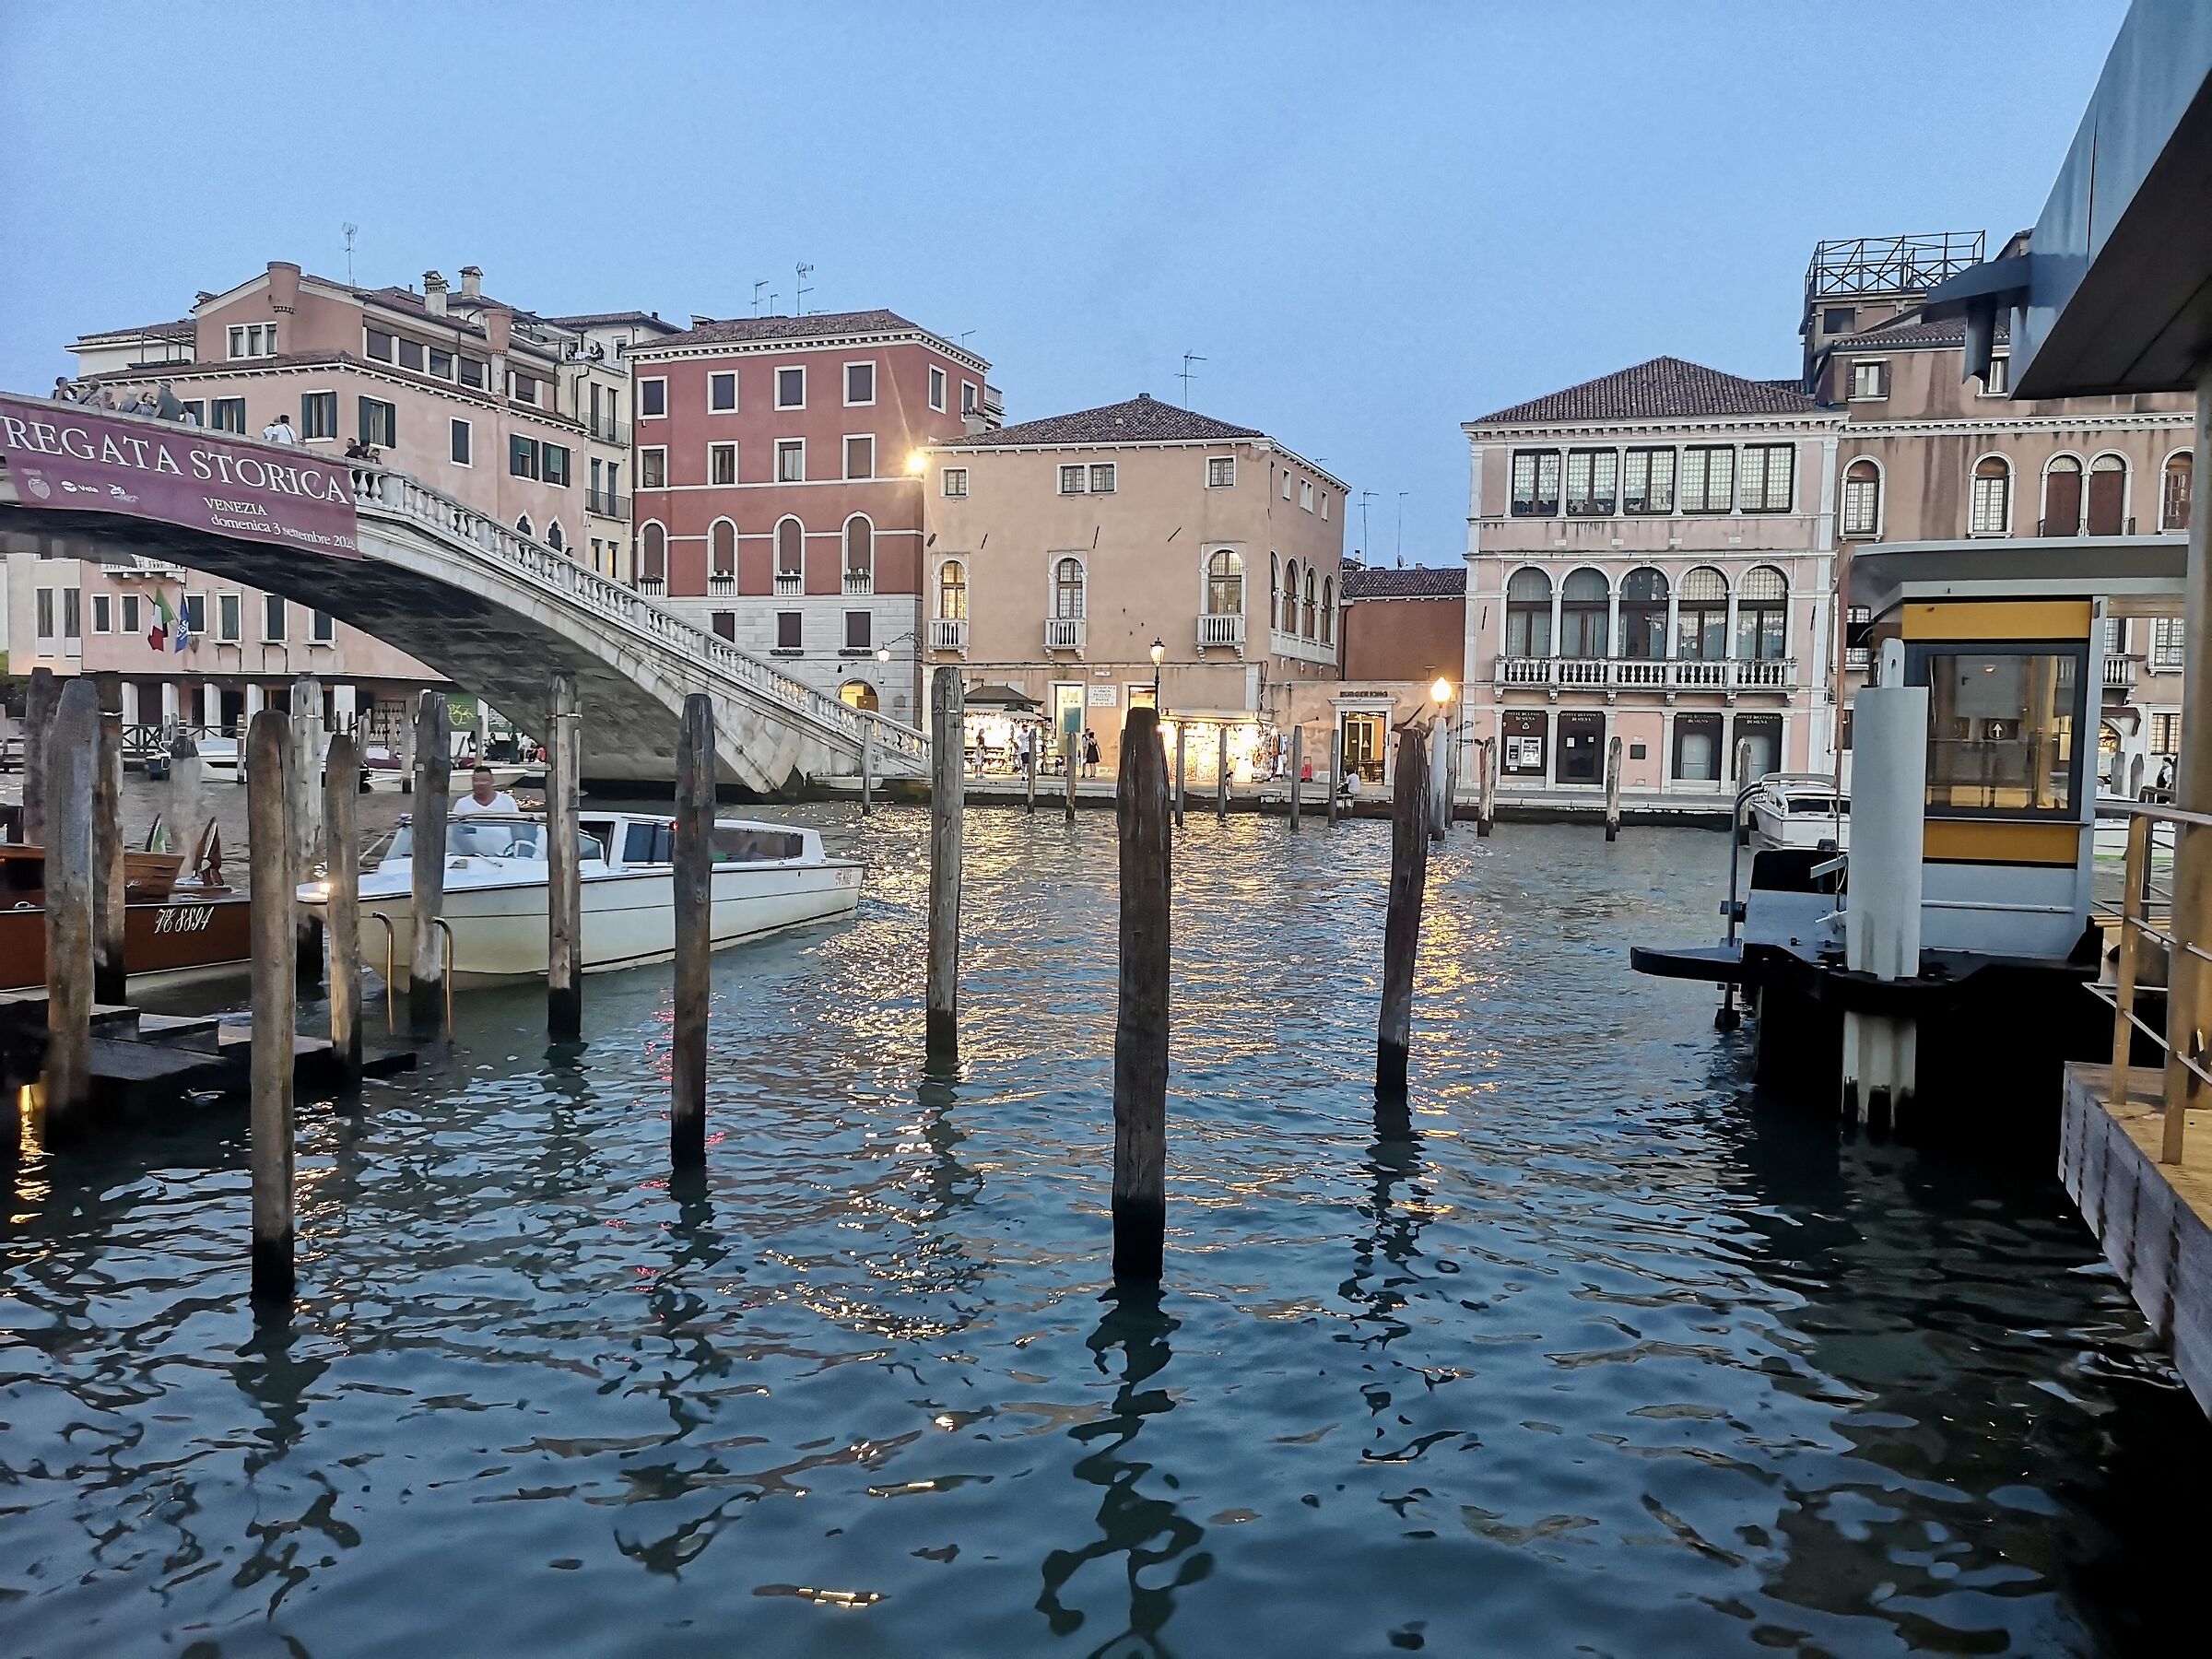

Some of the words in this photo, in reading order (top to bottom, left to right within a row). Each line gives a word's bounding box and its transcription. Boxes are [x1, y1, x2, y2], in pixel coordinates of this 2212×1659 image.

[0, 416, 183, 476] REGATA
[189, 450, 350, 505] STORICA
[77, 484, 99, 493] Vela
[203, 497, 268, 516] VENEZIA
[211, 513, 272, 534] domenica
[273, 522, 281, 535] 3
[282, 526, 331, 546] settembre
[175, 906, 215, 932] 8894
